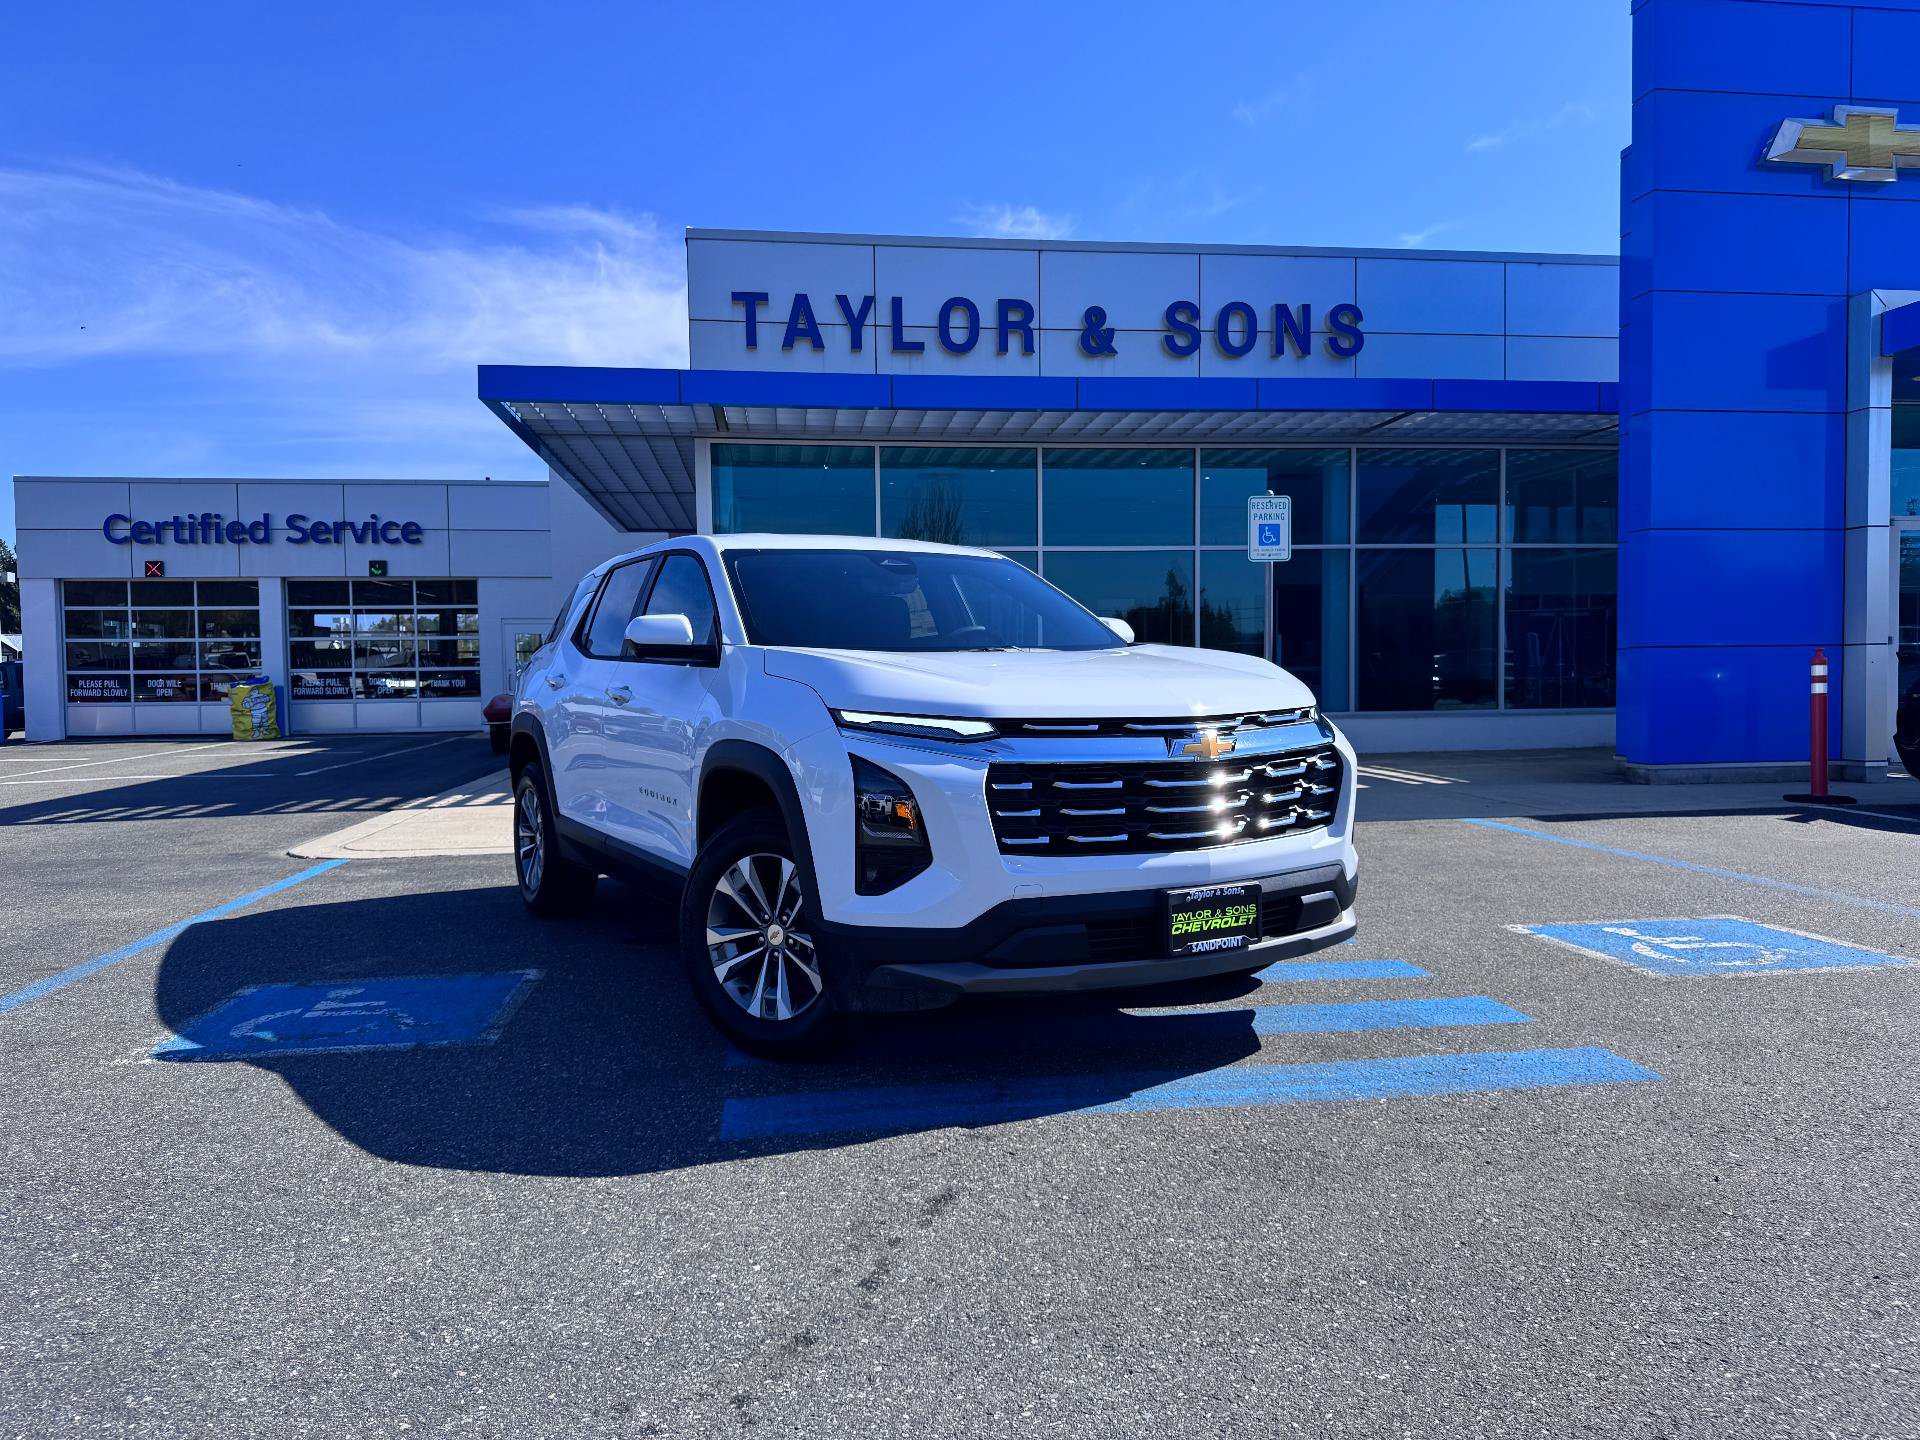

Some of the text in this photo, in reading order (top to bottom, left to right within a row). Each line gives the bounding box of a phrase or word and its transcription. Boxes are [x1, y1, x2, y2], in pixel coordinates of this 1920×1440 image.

[731, 291, 1364, 358] TAYLOR & SONS
[1251, 501, 1287, 510] RESERVED
[1253, 512, 1285, 521] PARKING
[103, 512, 424, 545] Certified Service
[78, 679, 120, 688] PLEASE PULL
[147, 679, 182, 688] DOOR WILL
[326, 678, 342, 686] PULL
[451, 679, 466, 688] YOU!
[70, 688, 128, 697] FORWARD SLOWLY
[156, 688, 173, 697] OPEN
[293, 686, 349, 696] FORWARD SLOWLY
[1189, 889, 1215, 901] Taylor
[1222, 886, 1241, 896] Sons
[1172, 904, 1256, 922] TAYLOR & SONS
[1171, 914, 1257, 935] CHEVROLET
[1191, 936, 1243, 953] SANDPOINT
